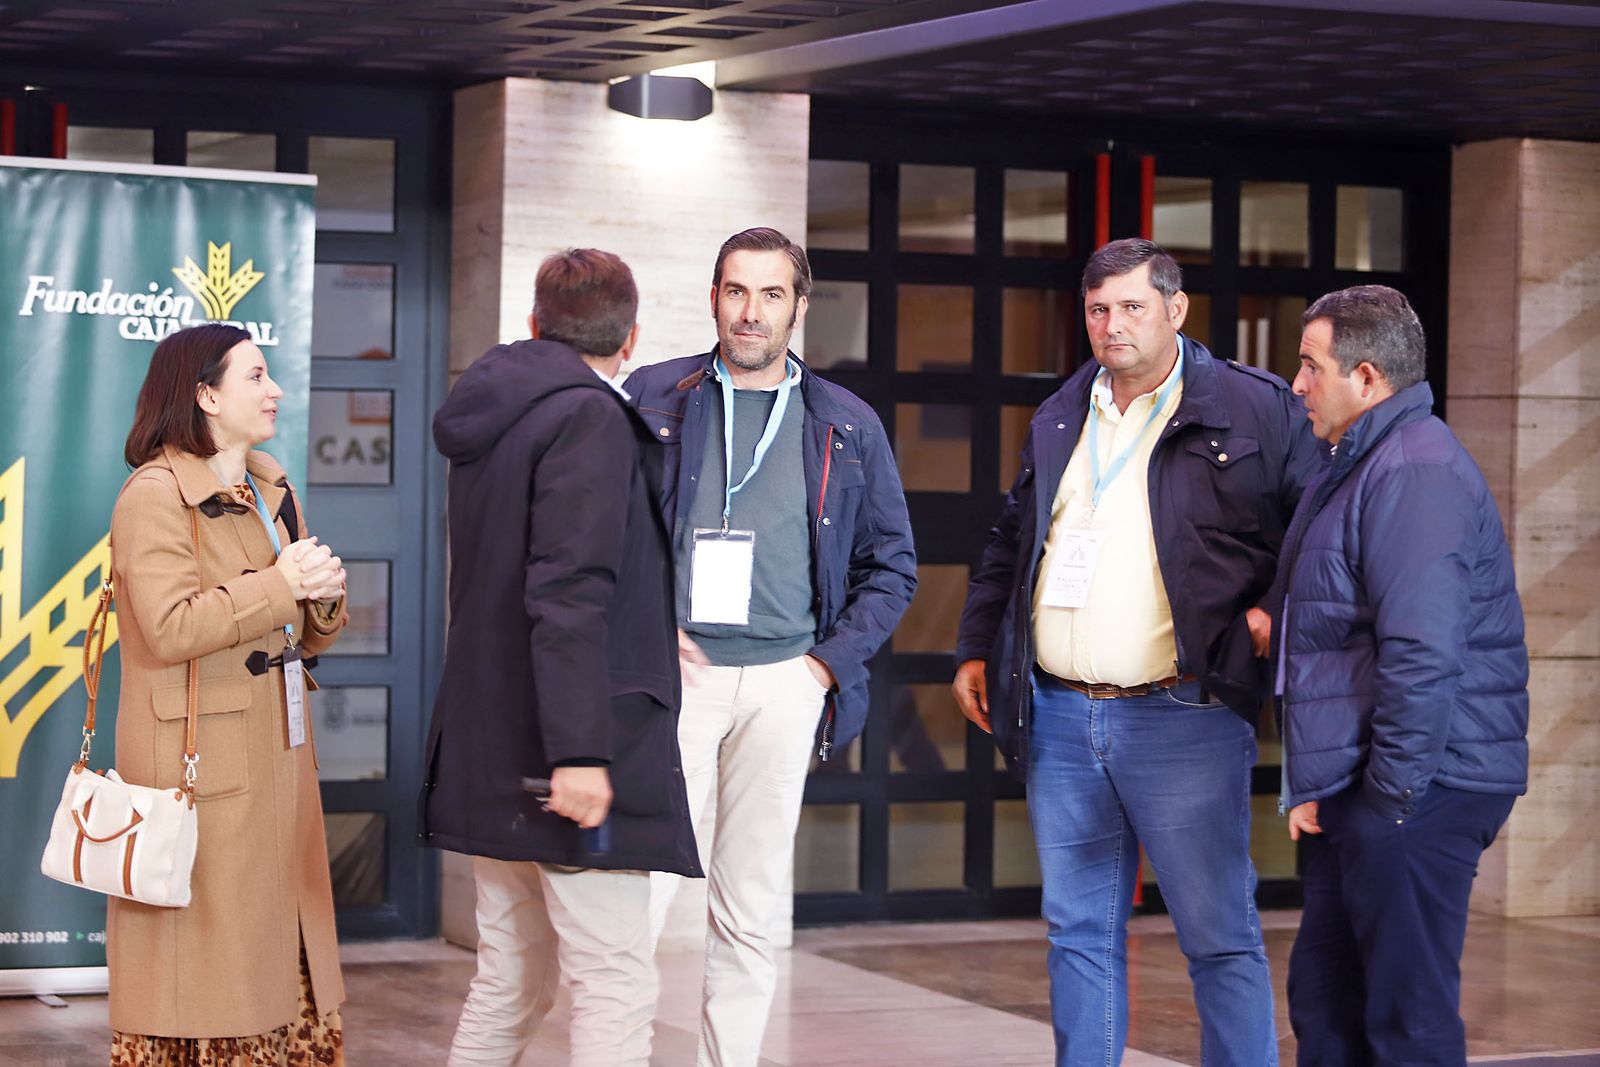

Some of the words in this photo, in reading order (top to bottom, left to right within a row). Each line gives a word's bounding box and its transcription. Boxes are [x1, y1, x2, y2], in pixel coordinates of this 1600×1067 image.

[18, 275, 194, 326] Fundación
[21, 931, 44, 943] 310
[45, 930, 69, 943] 902
